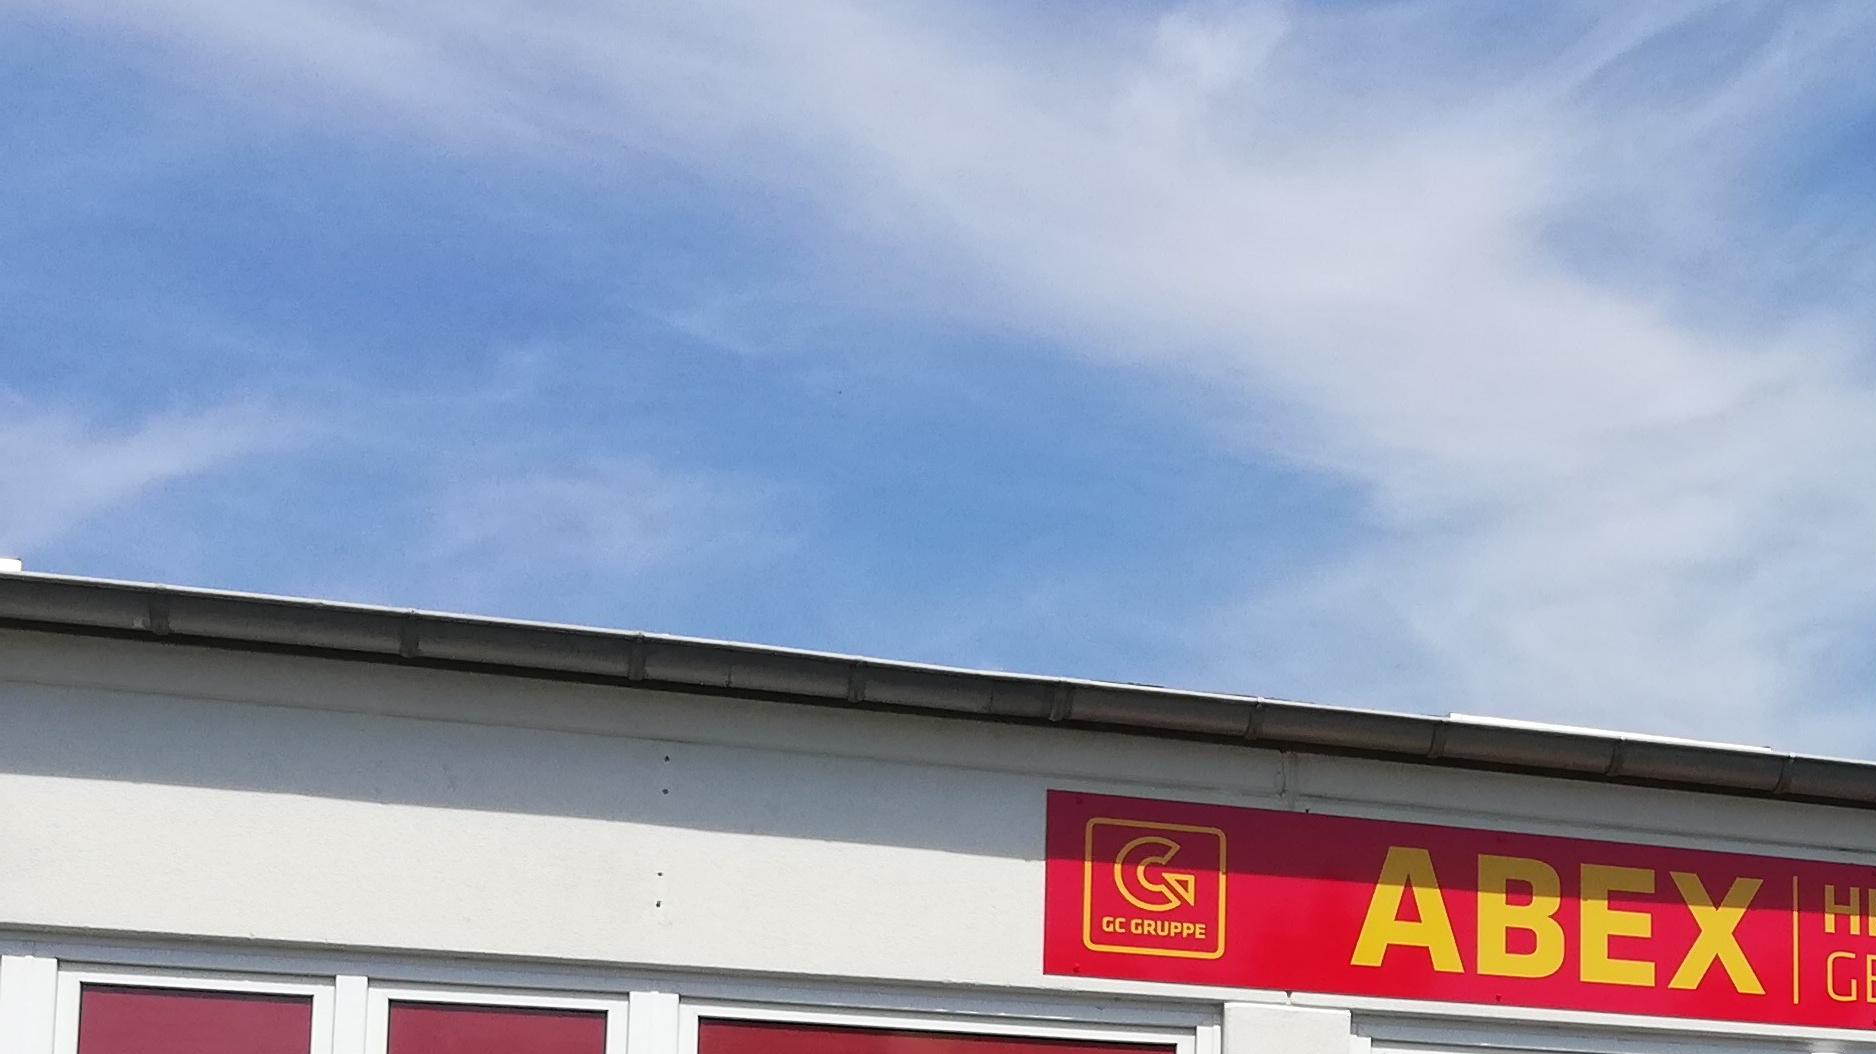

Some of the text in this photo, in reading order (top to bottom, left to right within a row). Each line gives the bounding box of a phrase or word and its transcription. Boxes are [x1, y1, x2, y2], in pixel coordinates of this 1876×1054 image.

[1102, 916, 1206, 940] GC GRUPPE
[1350, 847, 1765, 995] ABEX
